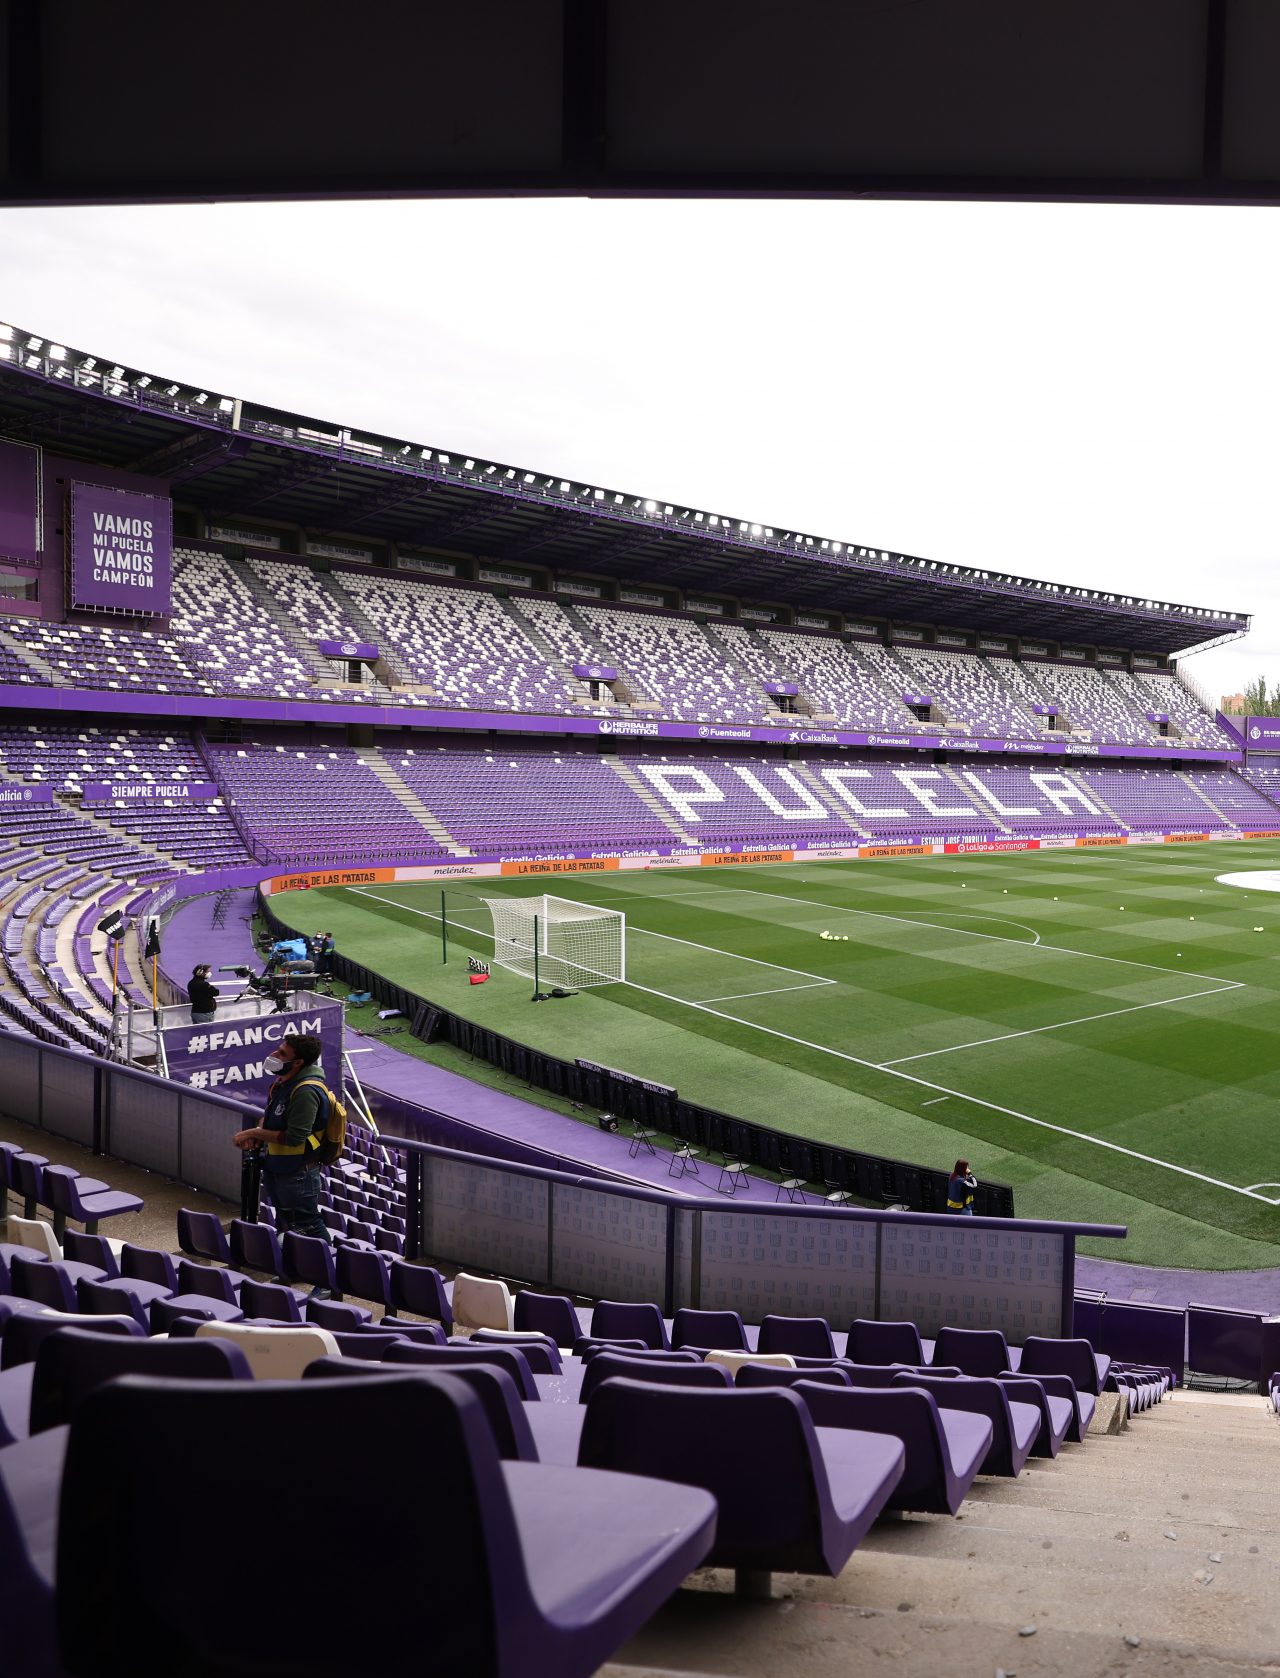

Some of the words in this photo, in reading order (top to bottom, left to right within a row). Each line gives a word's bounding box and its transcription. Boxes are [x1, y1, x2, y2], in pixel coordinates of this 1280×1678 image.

[93, 512, 153, 539] VAMOS
[93, 533, 108, 546] MI
[112, 536, 154, 553] PUCELA
[93, 547, 153, 573] VAMOS
[93, 568, 154, 588] CAMPEÓN
[613, 721, 658, 730] HERBALIFE
[613, 727, 659, 735] NUTRITION
[710, 729, 751, 738] Fuenteolid
[801, 732, 838, 743] CaixaBank
[877, 737, 909, 745] Fuenteolid
[948, 740, 980, 749] CaixaBank
[0, 789, 22, 801] alicia
[112, 786, 153, 797] SIEMPRE
[155, 785, 189, 797] PUCELA
[637, 764, 1102, 821] PUCELA
[807, 841, 830, 849] Estrella
[831, 840, 851, 848] Galicia
[921, 837, 945, 846] ESTADIO
[946, 834, 961, 844] JOSÉ
[671, 848, 698, 856] Estrella
[699, 846, 723, 854] Galicia
[743, 844, 767, 852] Estrella
[768, 843, 790, 851] Galicia
[966, 843, 988, 852] LaLiga
[994, 842, 1028, 851] Santander
[650, 857, 680, 865] meléndez
[761, 854, 782, 862] PATATAS
[434, 866, 473, 875] meléndez
[519, 865, 528, 873] LA
[553, 863, 561, 871] DE
[563, 863, 577, 871] LAS
[579, 861, 605, 870] PATATAS
[281, 881, 288, 890] LA
[311, 876, 320, 886] DE
[323, 874, 339, 884] LAS
[342, 872, 376, 883] PATATAS
[187, 1017, 322, 1054] #FANCAM
